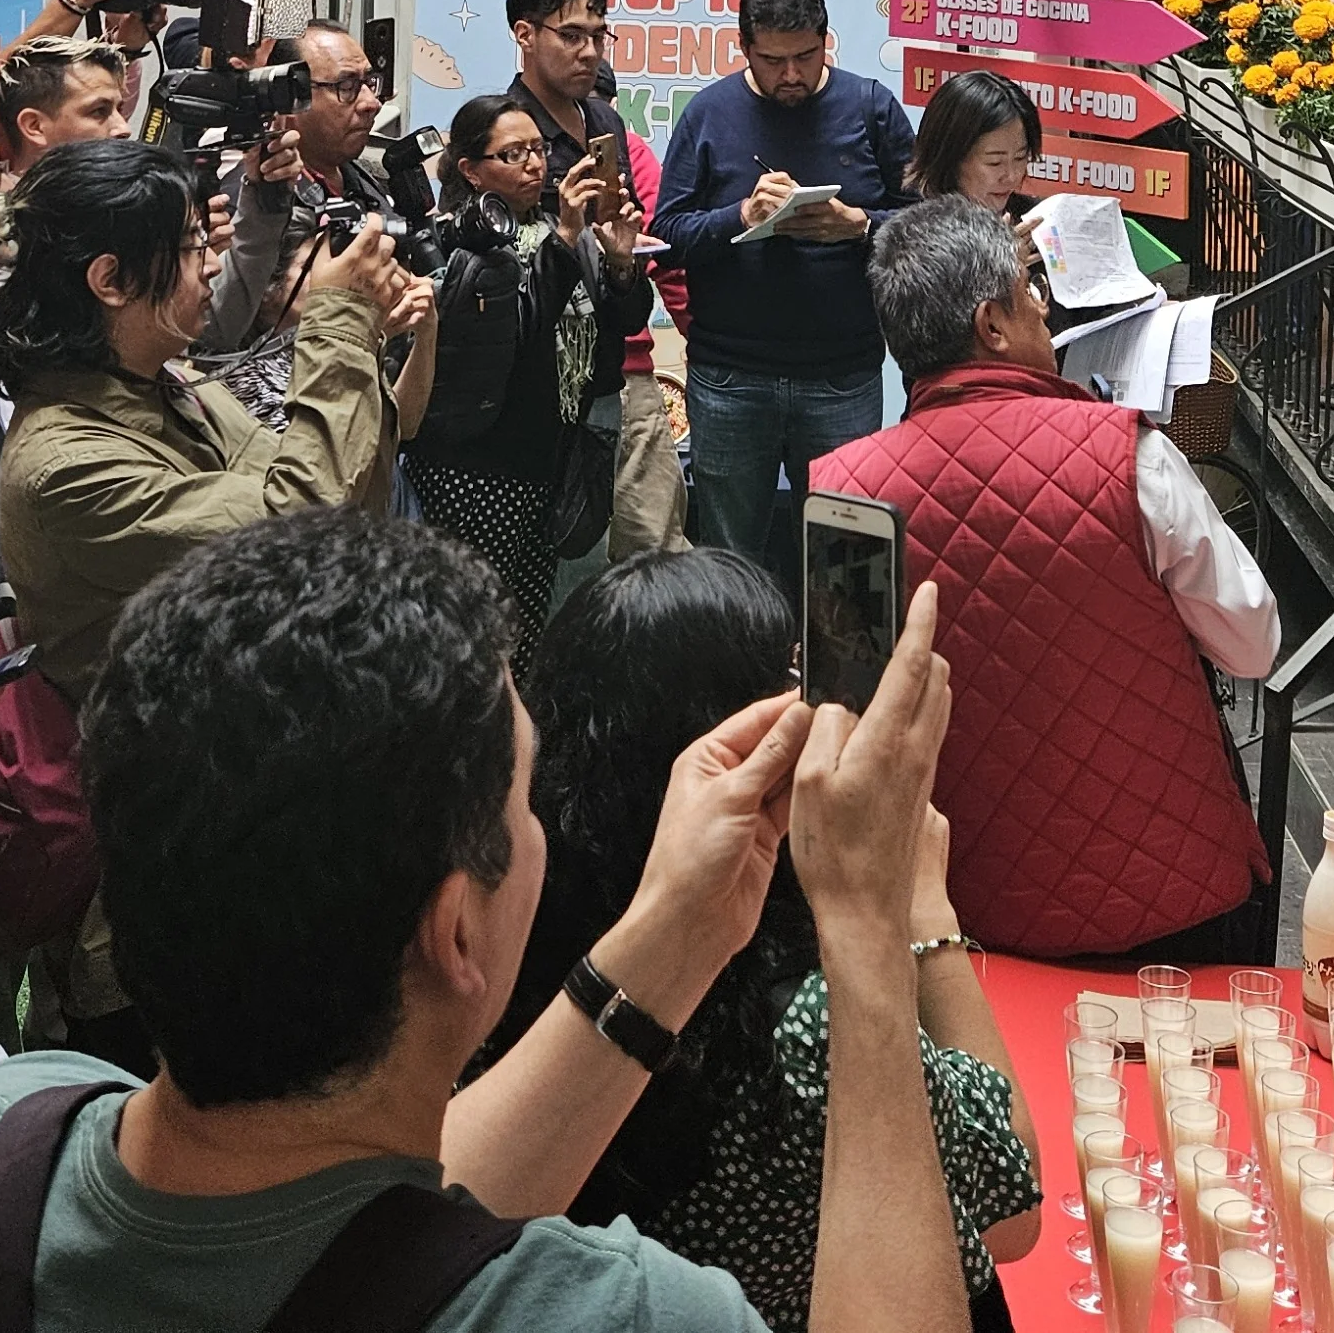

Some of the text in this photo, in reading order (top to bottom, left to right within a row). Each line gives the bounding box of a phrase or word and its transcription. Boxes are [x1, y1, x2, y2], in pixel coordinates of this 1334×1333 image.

[935, 11, 1019, 44] K-FOOD
[1025, 0, 1090, 24] COCINA
[913, 67, 935, 93] 1F
[1058, 86, 1138, 123] K-FOOD
[145, 107, 164, 143] Nikon
[1076, 161, 1136, 193] FOOD
[1145, 168, 1171, 197] 1F
